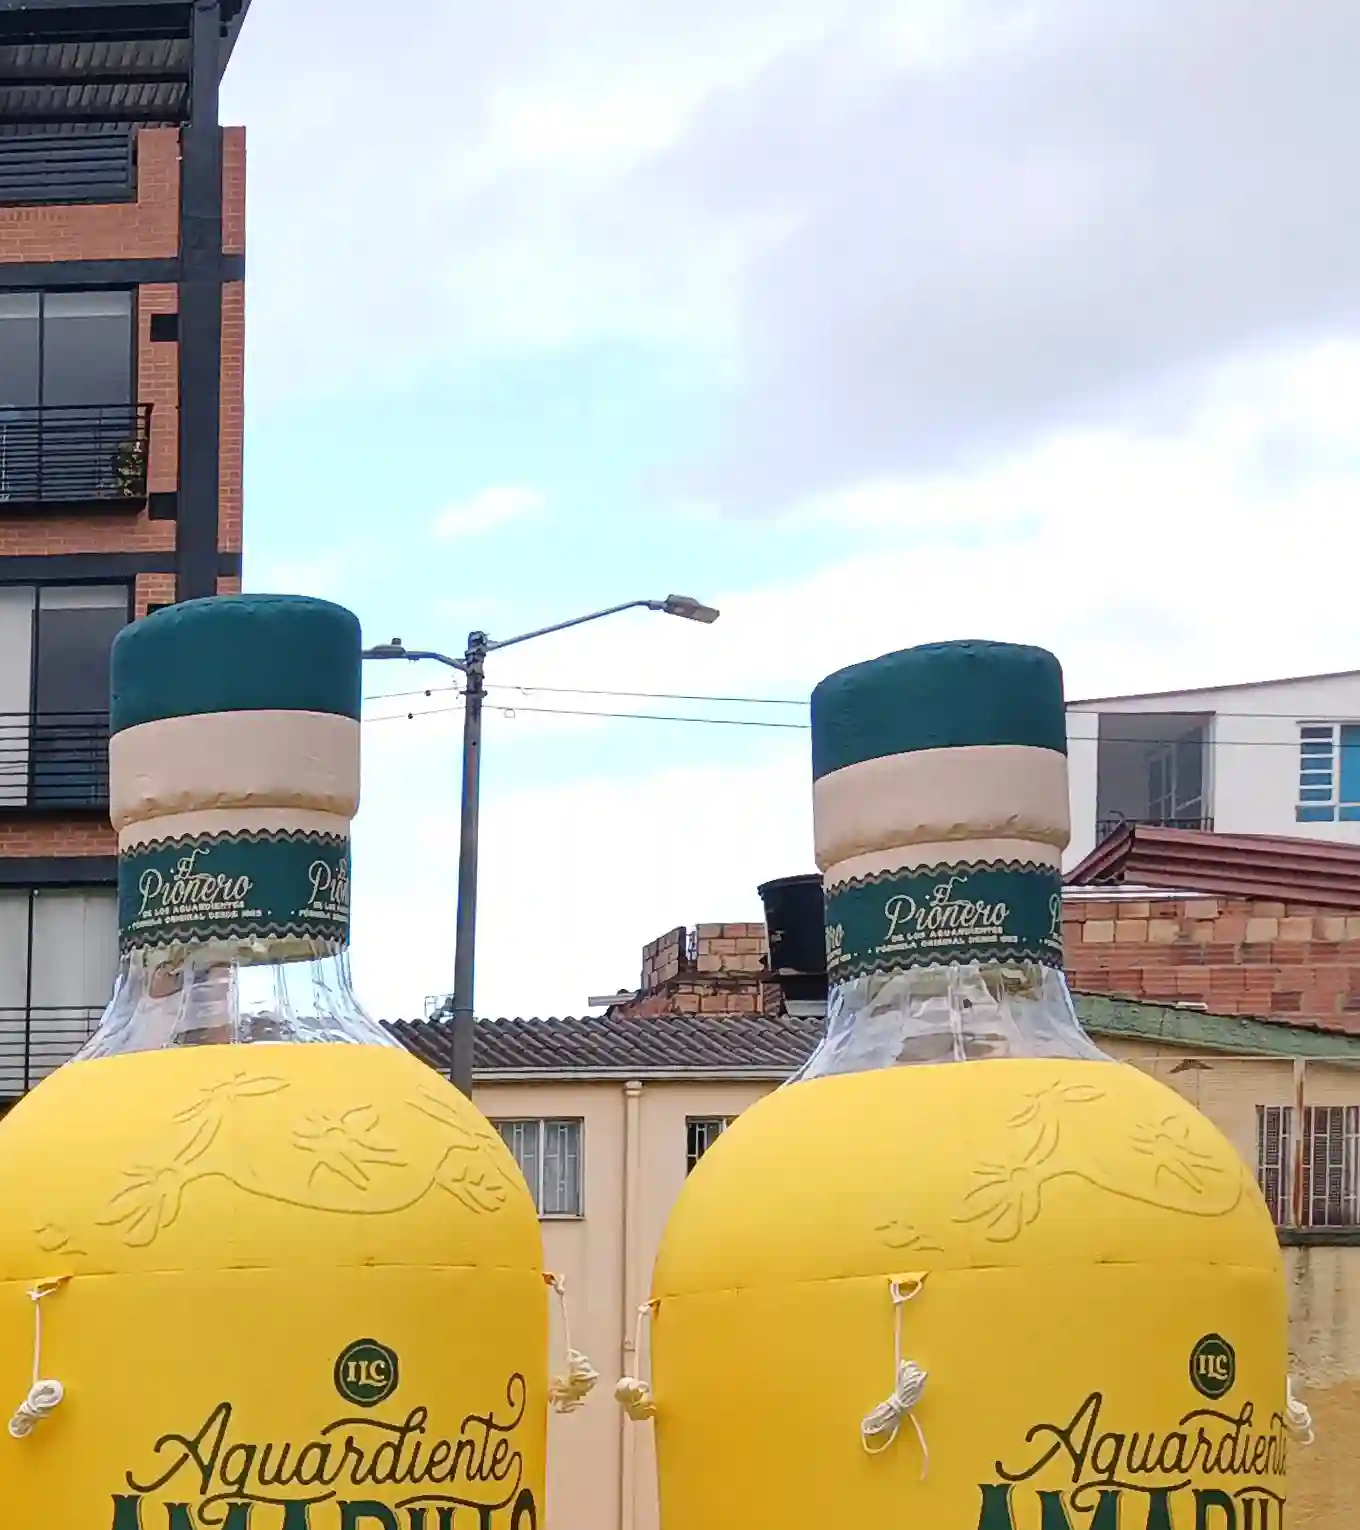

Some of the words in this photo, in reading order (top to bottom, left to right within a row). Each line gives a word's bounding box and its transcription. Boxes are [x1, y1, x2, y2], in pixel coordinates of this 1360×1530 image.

[137, 868, 254, 916] Pionero
[883, 894, 1011, 941] Pionero
[346, 1358, 387, 1388] ILC
[1198, 1353, 1229, 1381] ILC
[126, 1372, 528, 1525] Aguardiente
